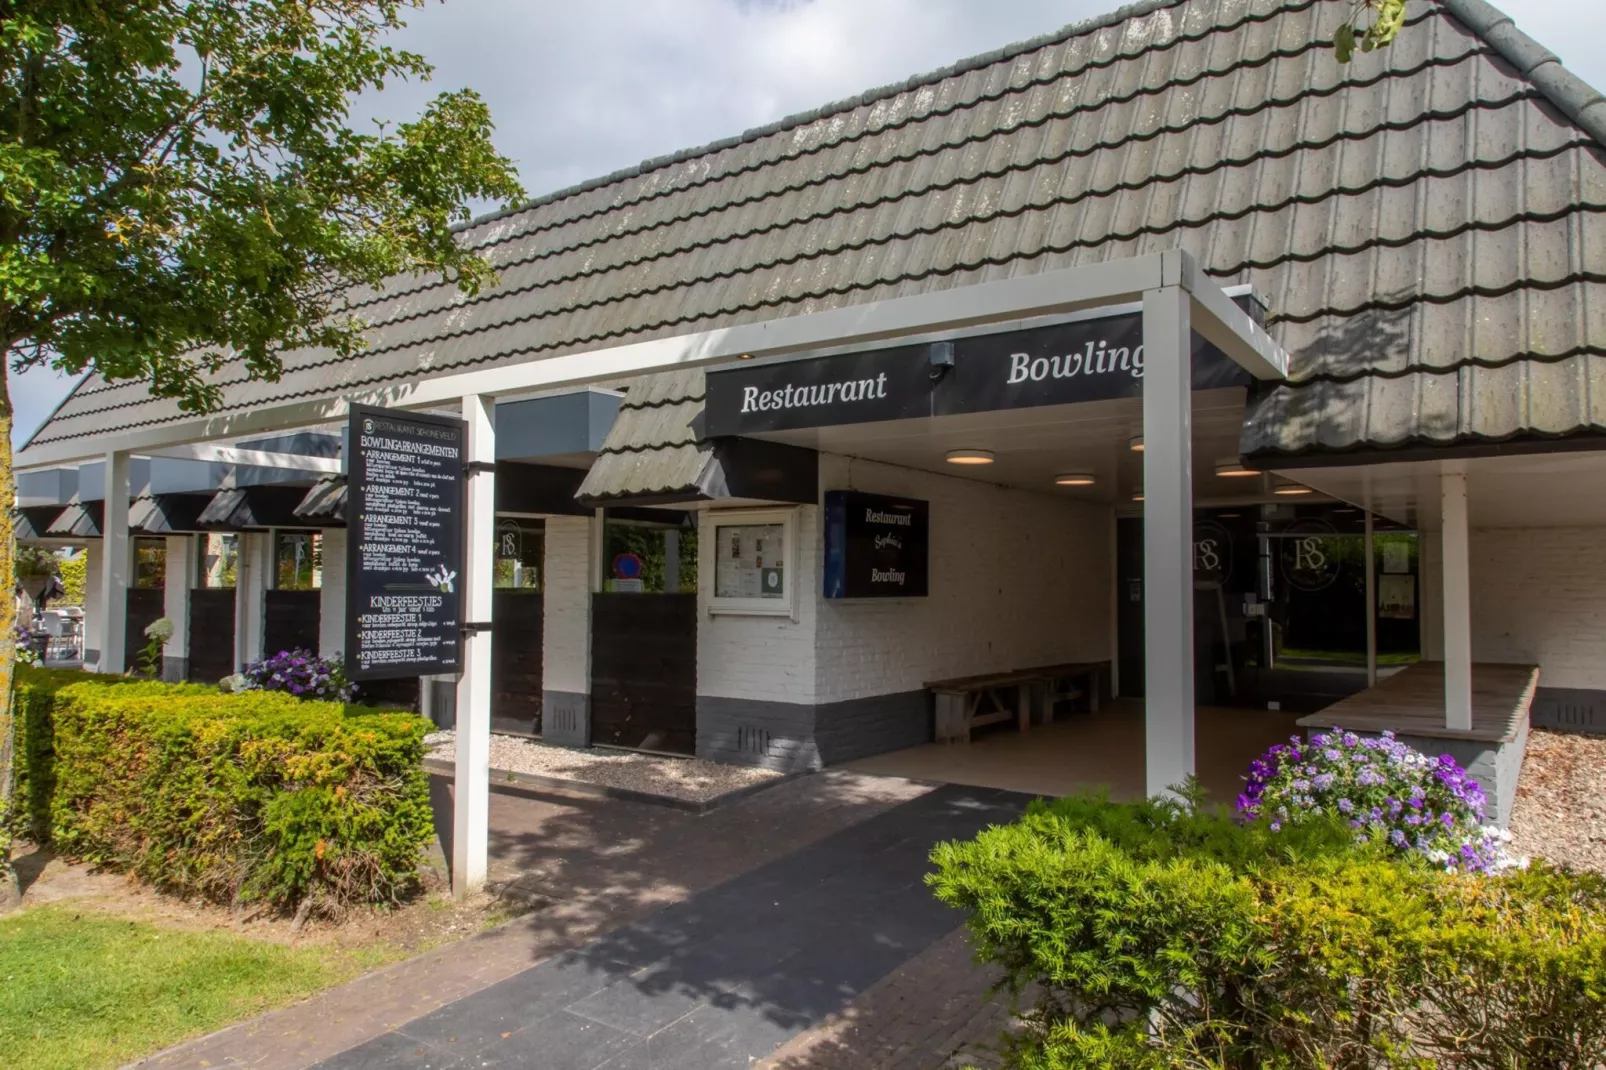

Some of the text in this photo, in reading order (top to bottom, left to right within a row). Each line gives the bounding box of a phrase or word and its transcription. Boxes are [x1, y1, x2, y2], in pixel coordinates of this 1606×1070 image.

[741, 372, 887, 413] Restaurant
[361, 435, 459, 458] BOWLINGARRANGEMENTEN
[366, 450, 416, 463] ARRANGEMENT
[417, 456, 421, 464] 1
[365, 484, 415, 497] ARRANGEMENT
[415, 488, 420, 497] 2
[364, 514, 413, 525] ARRANGEMENT
[866, 508, 911, 526] Restaurant
[363, 543, 412, 554] ARRANGEMENT
[411, 545, 416, 554] 4
[871, 567, 906, 586] Bowling
[370, 596, 443, 608] KINDERFEESTJES
[361, 613, 422, 624] KINDERFEESTJE 1
[361, 629, 417, 640] KINDERFEESTJE
[417, 629, 422, 638] 2
[361, 649, 415, 660] KINDERFEESTJE
